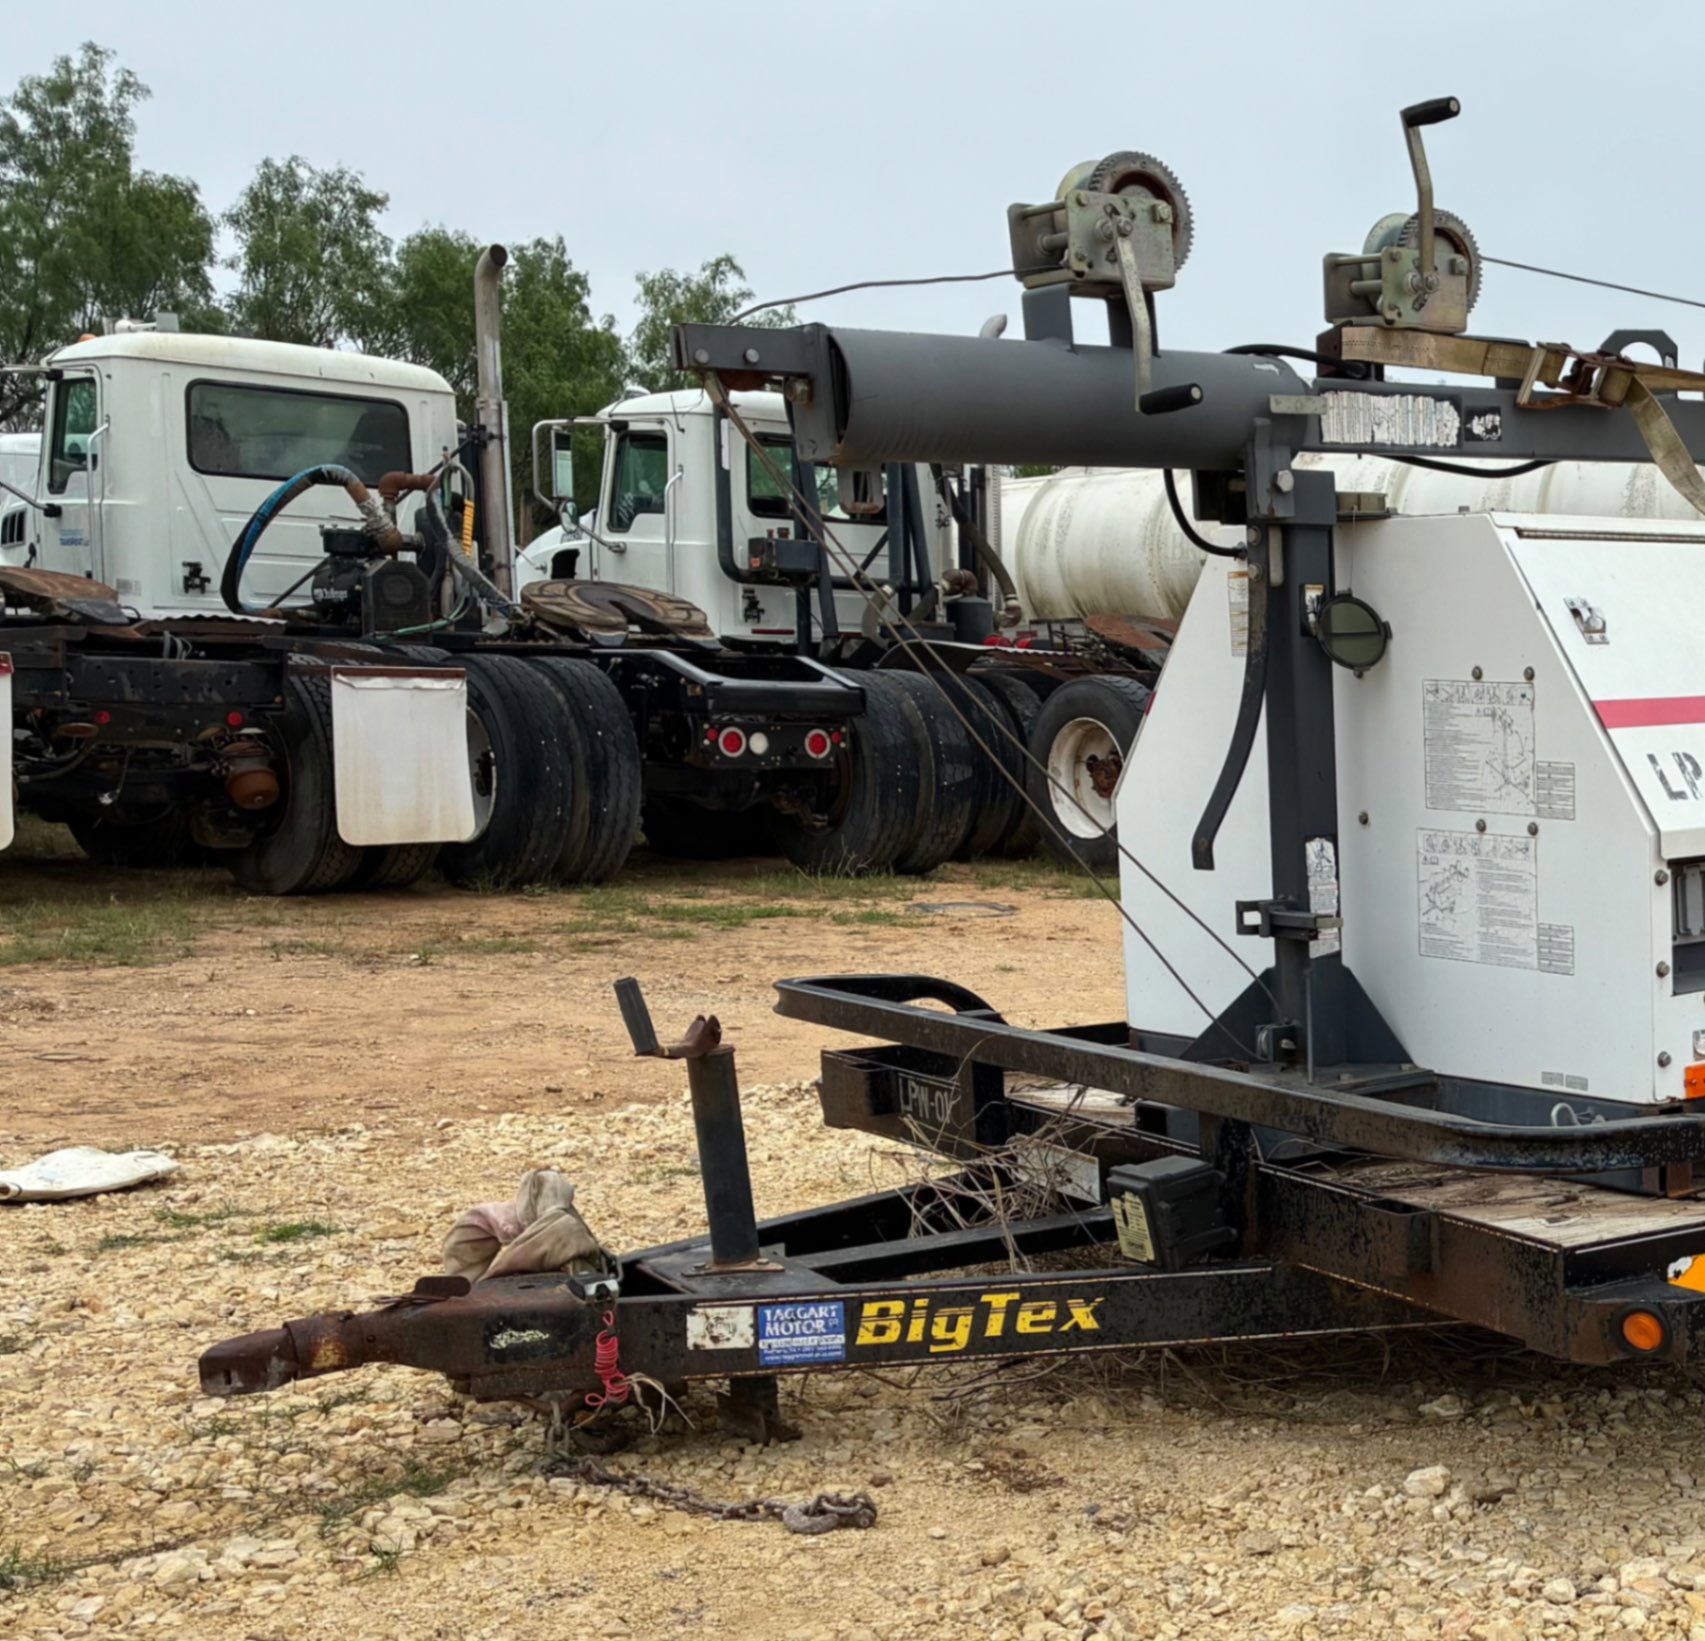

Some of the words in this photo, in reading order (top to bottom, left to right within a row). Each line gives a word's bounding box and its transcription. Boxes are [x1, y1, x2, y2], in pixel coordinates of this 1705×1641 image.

[764, 1305, 839, 1322] TAGGART
[855, 1292, 1105, 1352] BigTex
[765, 1318, 827, 1337] MOTOR
